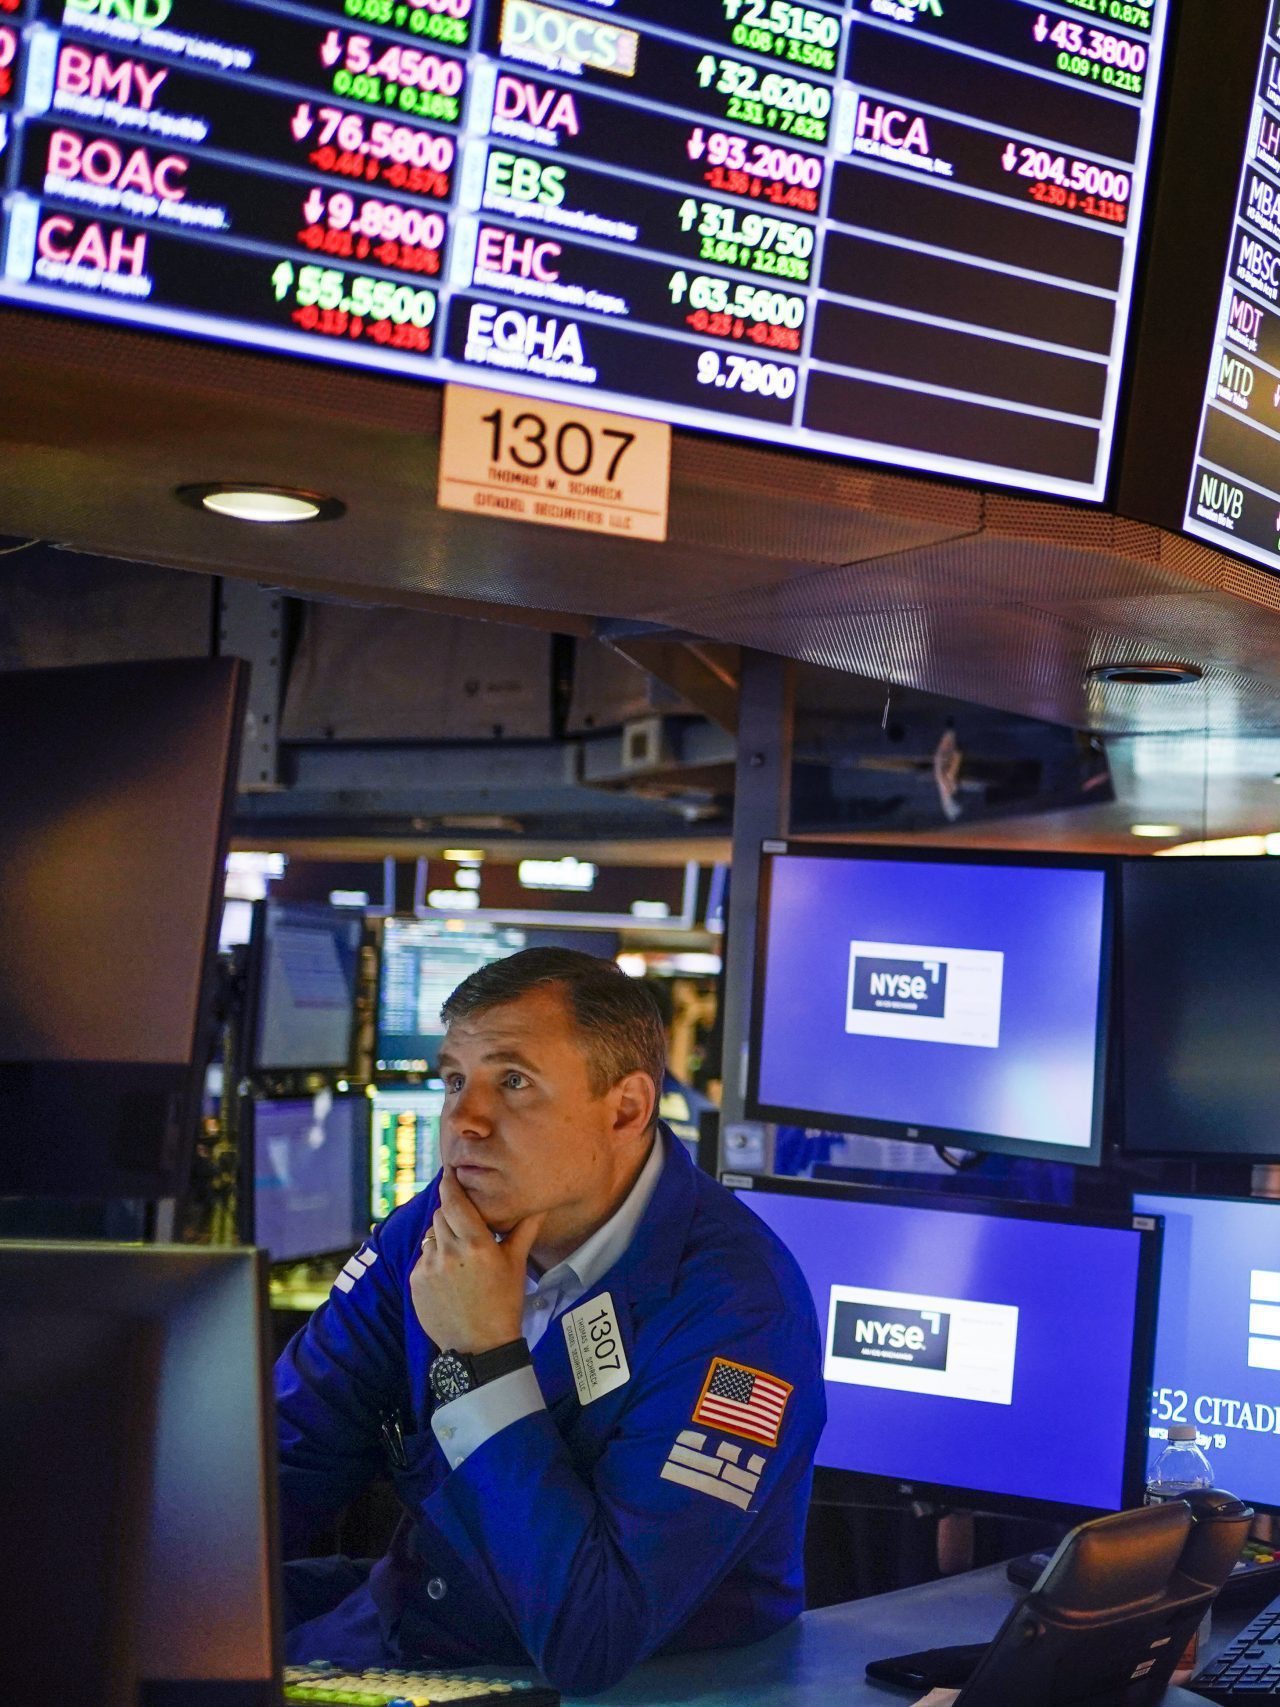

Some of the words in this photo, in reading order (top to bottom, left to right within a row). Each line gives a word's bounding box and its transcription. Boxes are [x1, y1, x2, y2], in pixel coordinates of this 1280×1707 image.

[502, 3, 618, 69] DOCS
[741, 0, 839, 48] 2.5150
[1050, 20, 1146, 73] 43.3800
[57, 45, 170, 110] BMY
[345, 34, 463, 96] 5.4500
[716, 59, 831, 119] 32.6200
[1056, 52, 1090, 77] 0.09
[1101, 66, 1142, 93] 0.21%
[496, 76, 580, 136] DVA
[857, 100, 929, 155] HCA
[318, 106, 454, 172] 76.5800
[708, 132, 822, 189] 93.2000
[1260, 116, 1280, 155] LH
[47, 130, 189, 201] BOAC
[484, 150, 567, 207] EBS
[1018, 147, 1130, 202] 204.5000
[37, 215, 148, 276] CAH
[328, 192, 445, 249] 9.8900
[699, 202, 813, 259] 31.9750
[477, 227, 562, 282] EHC
[296, 264, 436, 328] 55.5500
[1230, 295, 1264, 338] MDT
[466, 303, 584, 366] EQHA
[697, 350, 797, 400] 9.7900
[1220, 354, 1253, 397] MTD
[481, 408, 636, 482] 1307
[1200, 474, 1243, 519] NUVB
[588, 1309, 621, 1371] 1307
[1214, 1433, 1227, 1449] 19
